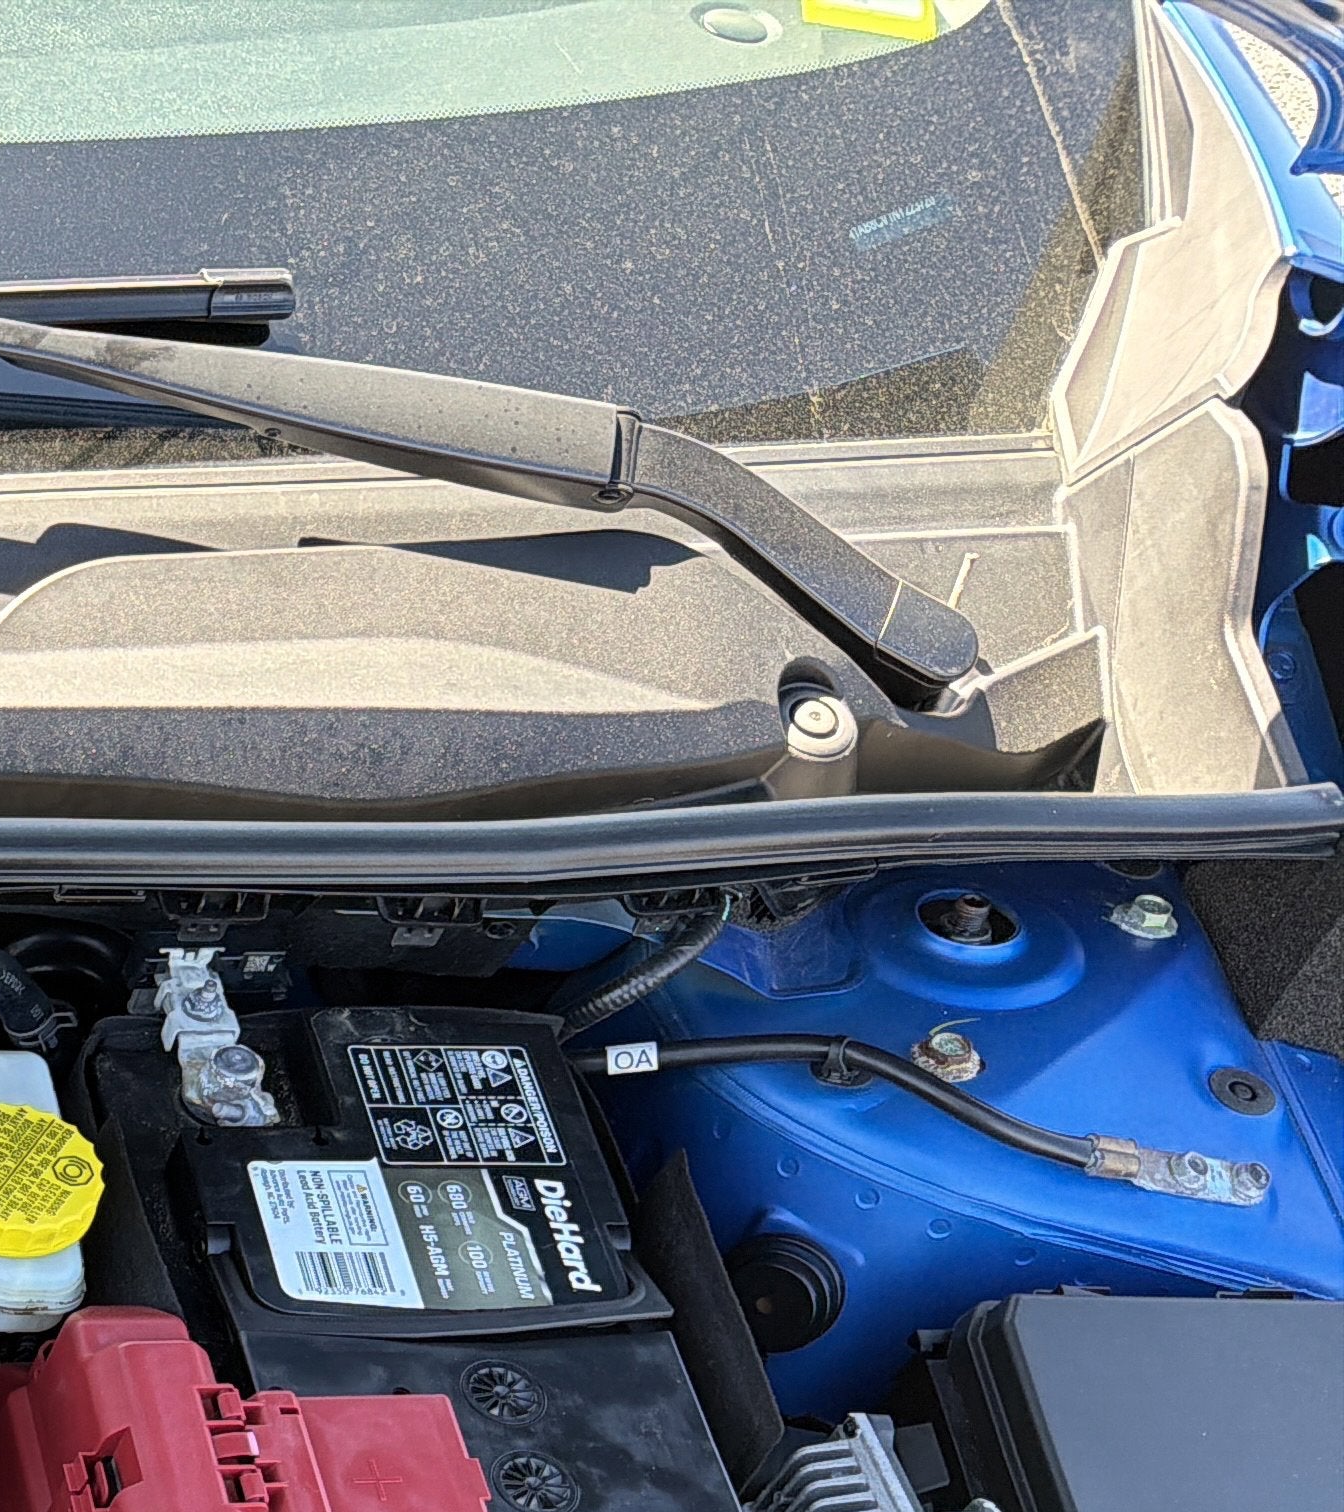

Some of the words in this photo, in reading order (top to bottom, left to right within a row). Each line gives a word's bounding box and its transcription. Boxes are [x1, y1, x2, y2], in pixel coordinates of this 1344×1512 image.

[516, 1068, 557, 1152] DANGER/POISON
[33, 1138, 51, 1157] FROM
[11, 1162, 32, 1185] SEALED
[297, 1169, 311, 1189] Lead
[304, 1192, 317, 1209] Acid
[405, 1184, 426, 1202] 60
[444, 1184, 468, 1209] 680
[512, 1179, 532, 1208] AGM
[310, 1170, 342, 1245] NON-SPILLABLE
[308, 1212, 327, 1244] Battery
[533, 1178, 602, 1294] DieHard
[418, 1224, 449, 1276] H5-AGM
[466, 1244, 488, 1269] 100
[498, 1231, 534, 1300] PLATINUM
